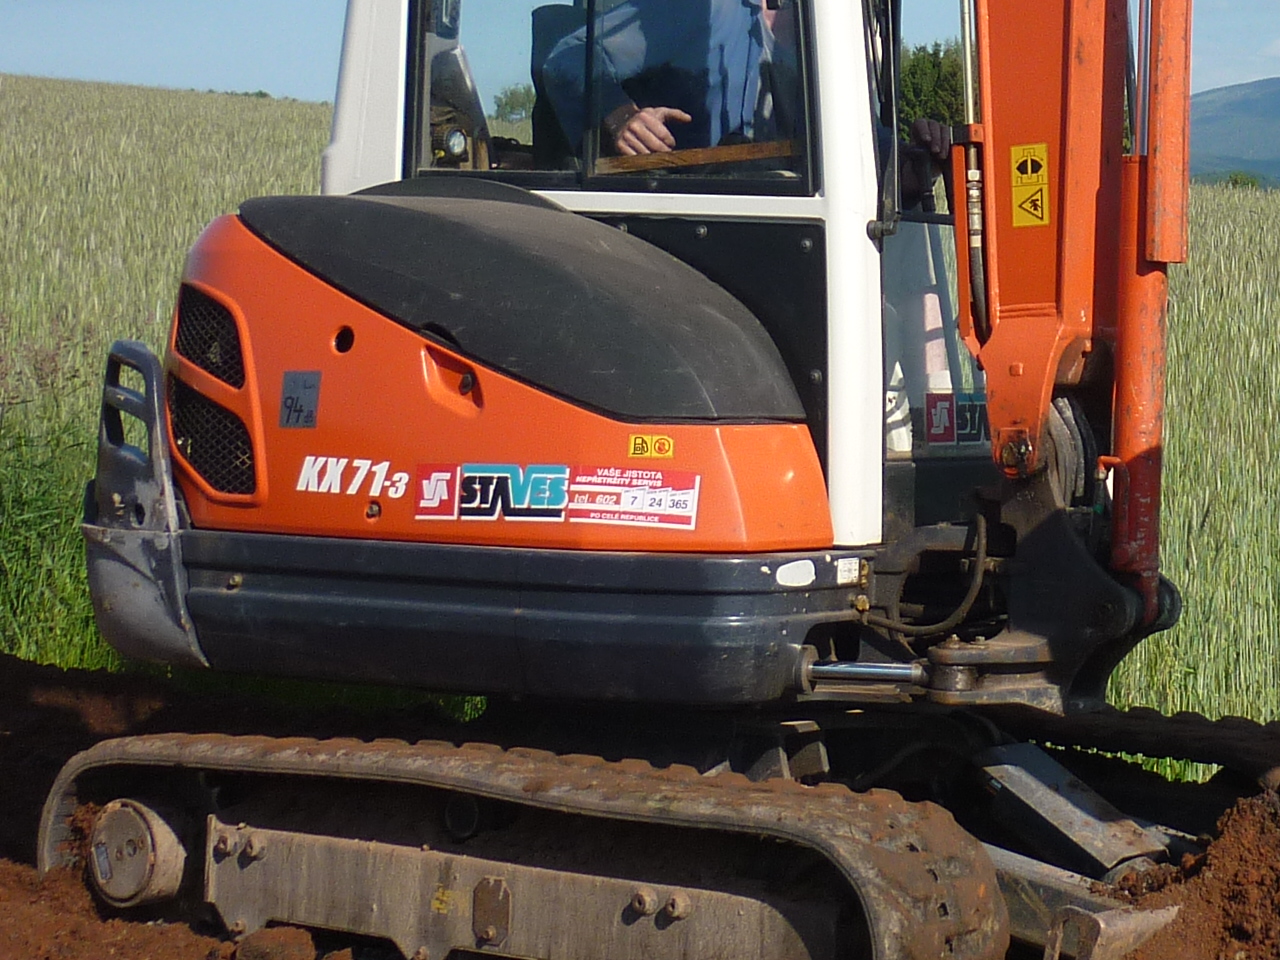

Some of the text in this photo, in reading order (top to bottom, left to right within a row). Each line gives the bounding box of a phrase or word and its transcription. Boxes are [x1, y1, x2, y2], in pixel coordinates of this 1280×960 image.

[284, 396, 304, 423] 94
[597, 467, 663, 480] VAŠE JISTOTA
[631, 479, 662, 487] SERVIS
[459, 463, 568, 520] STAVES
[596, 494, 617, 505] 602
[630, 495, 638, 506] 7
[648, 497, 663, 507] 24
[668, 499, 689, 510] 365
[601, 512, 619, 520] CELÉ
[620, 514, 659, 523] REPUBLICE
